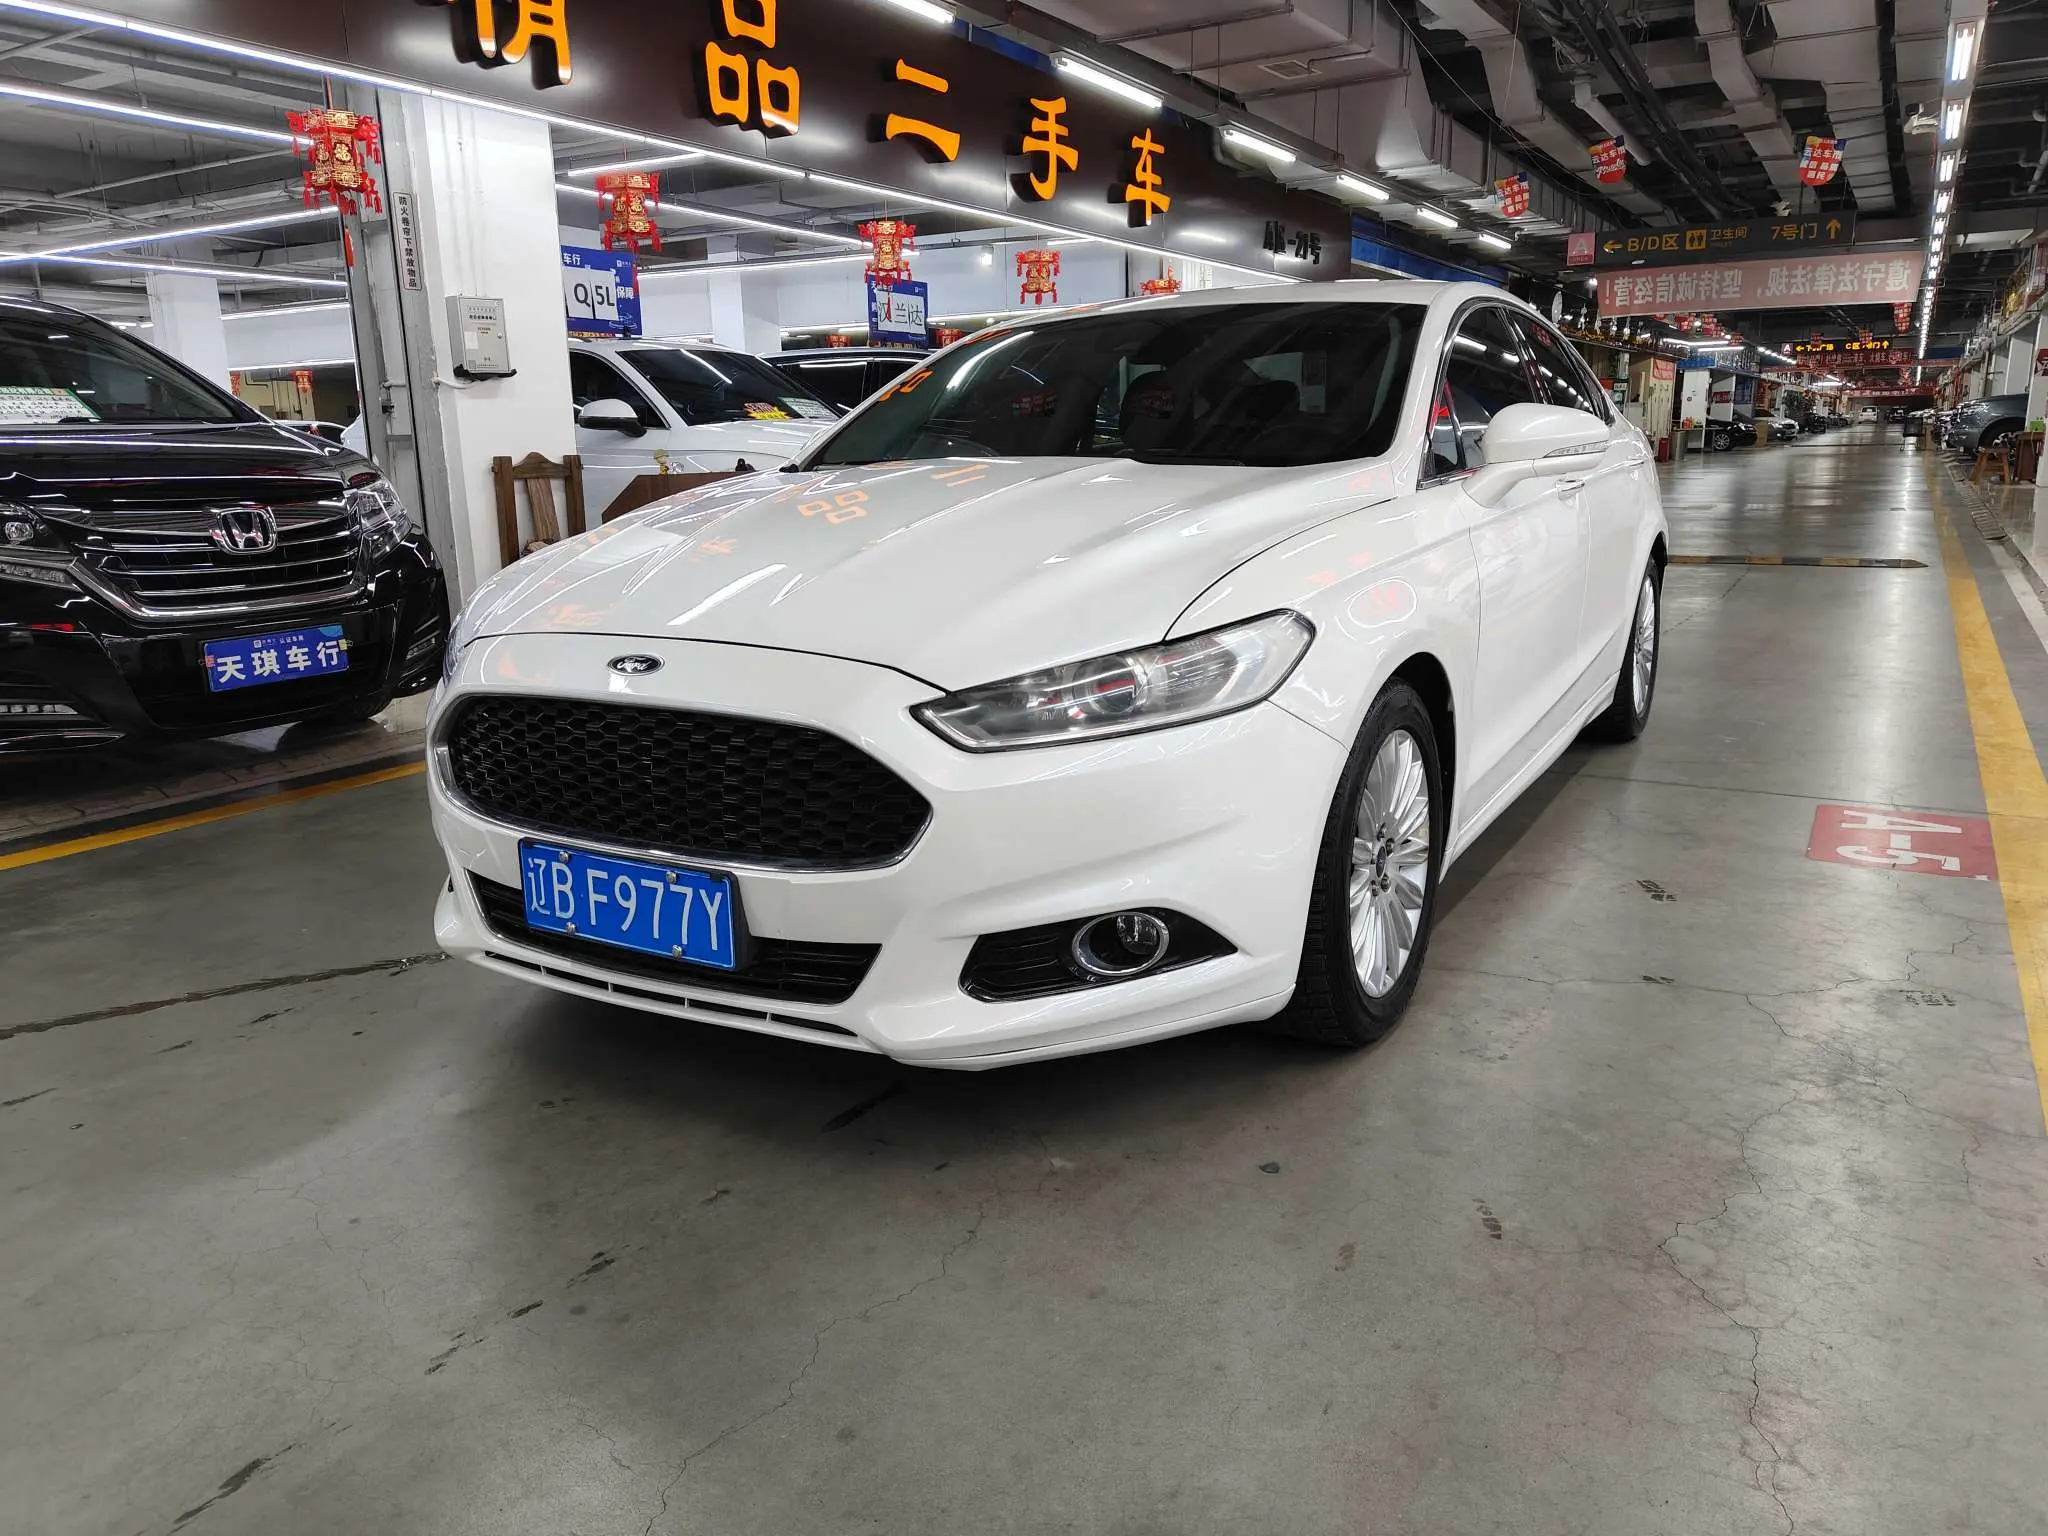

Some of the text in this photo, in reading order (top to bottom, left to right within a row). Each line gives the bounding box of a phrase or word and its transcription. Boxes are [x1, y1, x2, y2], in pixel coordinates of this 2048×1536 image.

[1710, 226, 1748, 240] 卫生间
[1771, 223, 1818, 240] 7号门
[1627, 233, 1680, 252] B/D区
[217, 640, 340, 684] 天琪车行
[616, 656, 652, 673] Ford
